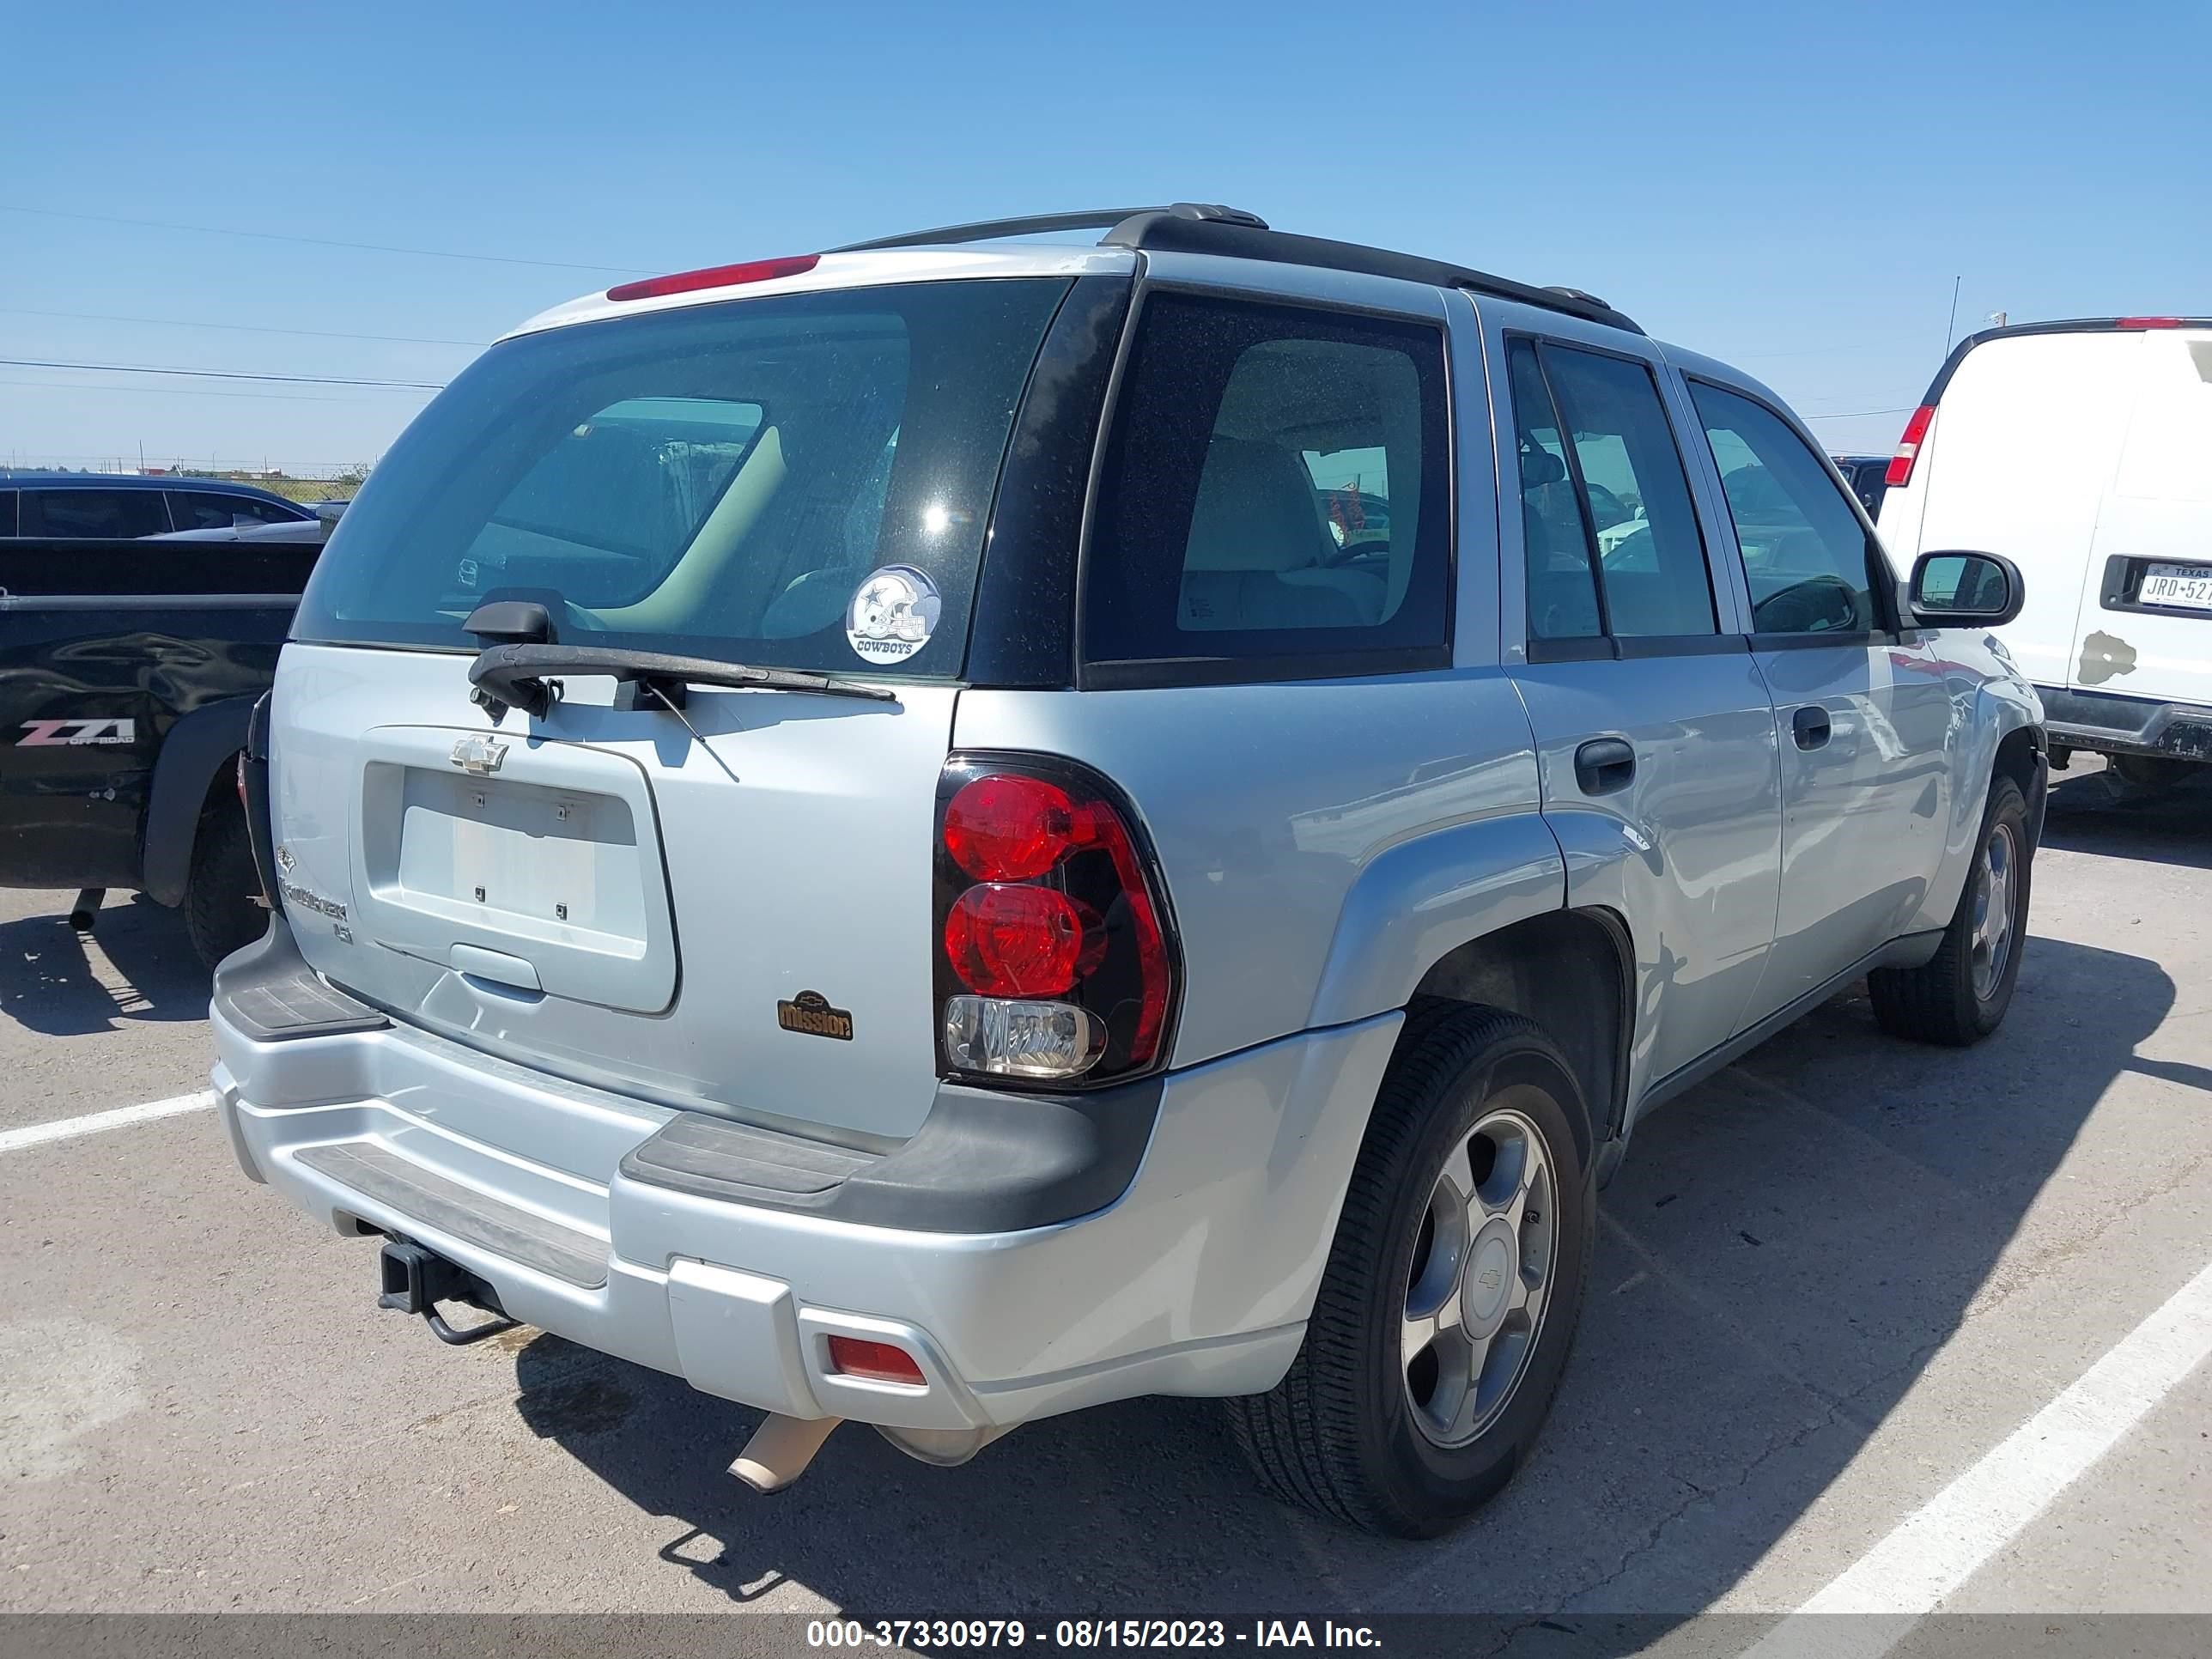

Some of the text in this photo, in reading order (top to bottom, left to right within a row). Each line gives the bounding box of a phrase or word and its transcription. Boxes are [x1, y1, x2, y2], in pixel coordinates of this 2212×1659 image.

[2175, 568, 2209, 578] TEXAS
[856, 641, 914, 654] COWBOYS
[15, 718, 136, 746] Z71
